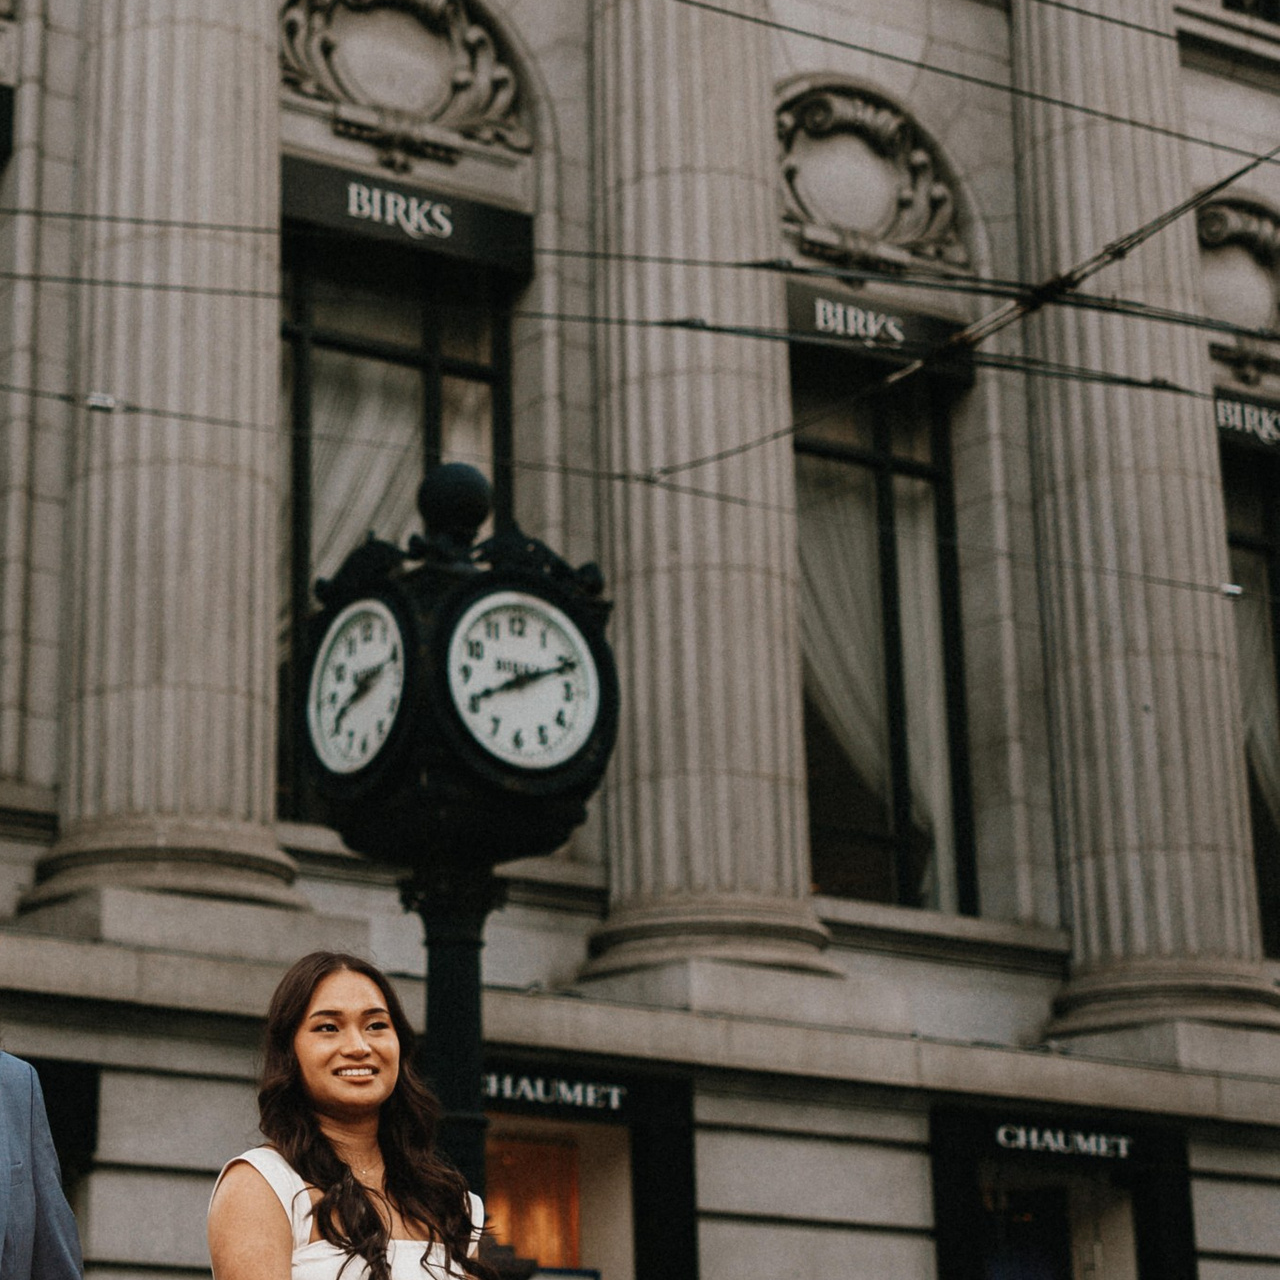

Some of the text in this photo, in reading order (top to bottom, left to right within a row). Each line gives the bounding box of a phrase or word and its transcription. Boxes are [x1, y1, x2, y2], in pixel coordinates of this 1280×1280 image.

[348, 182, 453, 240] BIRKS
[815, 298, 905, 349] BIRKS
[1216, 398, 1280, 445] BIRK
[997, 1124, 1133, 1159] CHAUMET
